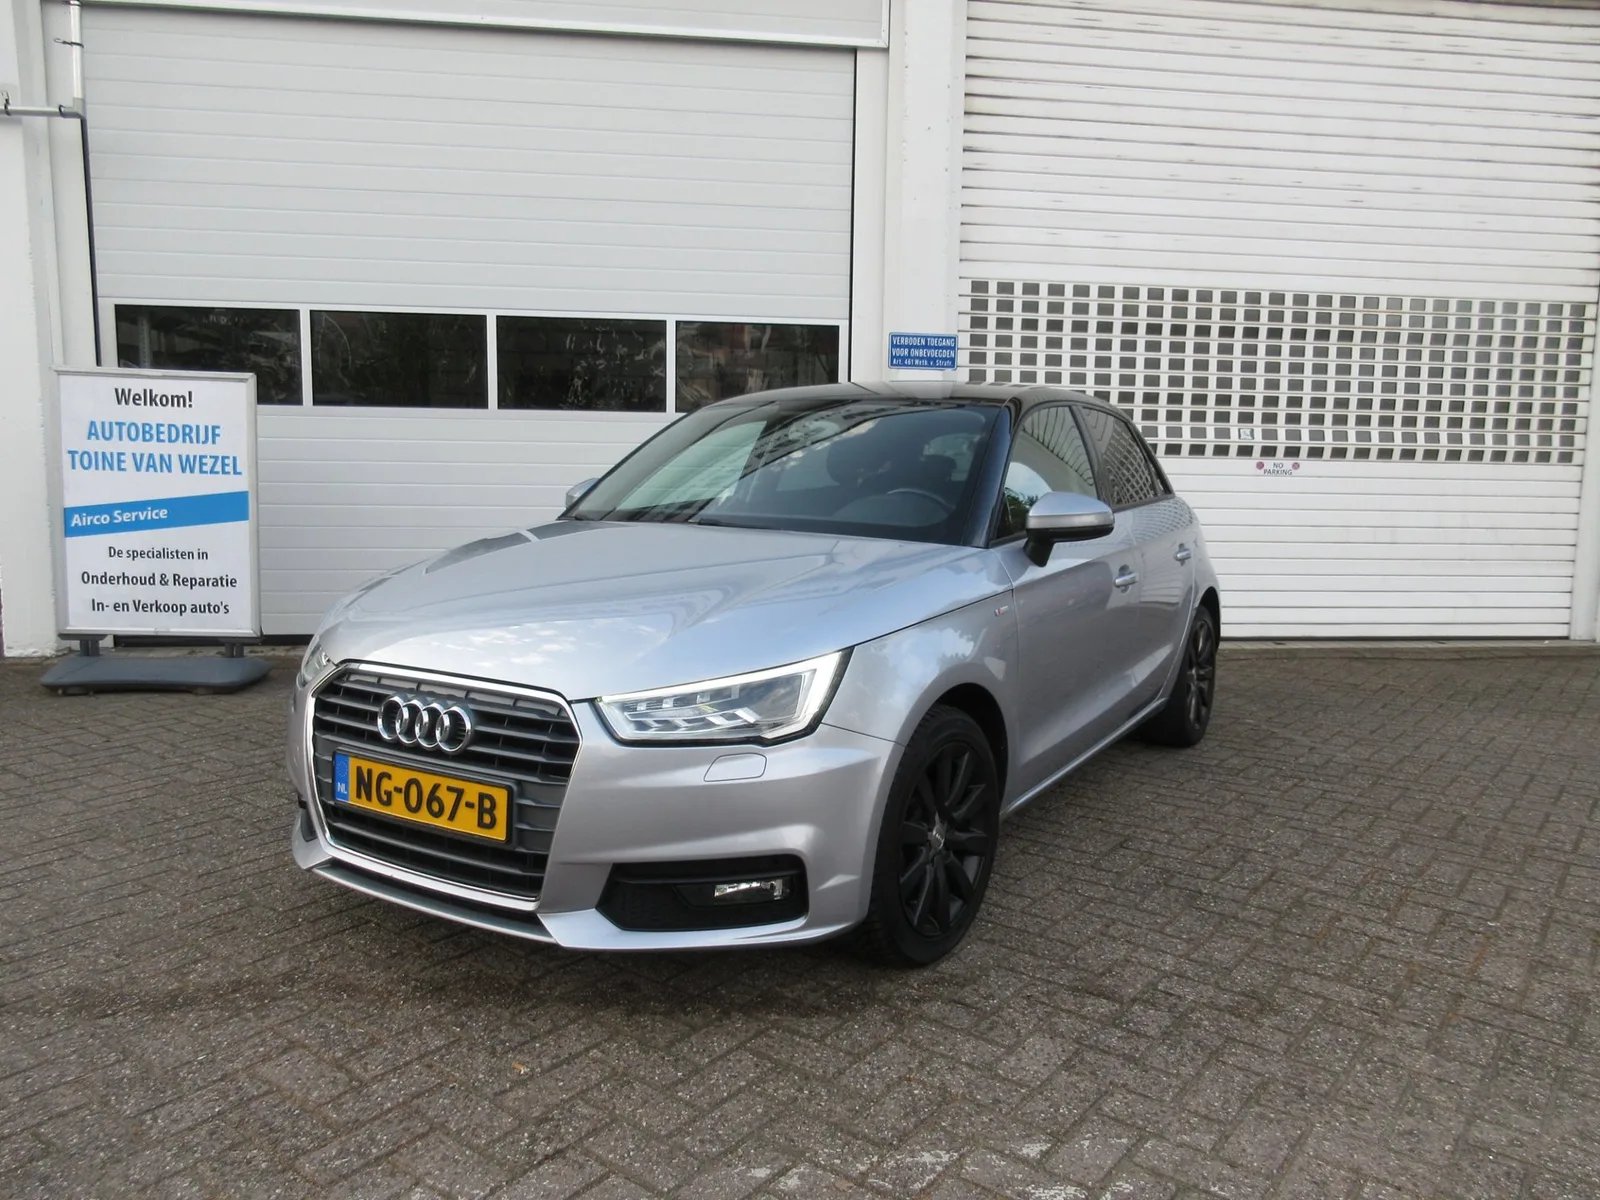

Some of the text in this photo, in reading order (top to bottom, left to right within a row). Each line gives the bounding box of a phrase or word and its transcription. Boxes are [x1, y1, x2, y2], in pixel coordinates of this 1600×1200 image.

[892, 336, 955, 347] VERBODEN TOEGANG
[892, 347, 955, 358] VOOR ONBEVOEGDEN
[115, 388, 193, 408] Welkom!
[87, 420, 221, 445] AUTOBEDRIJF
[68, 450, 242, 476] TOINE VAN WEZEL
[71, 507, 168, 528] Airco Service
[108, 546, 209, 562] De specialisten in
[81, 571, 238, 590] Onderhoud & Reparatie
[91, 599, 230, 616] In- en Verkoop auto's
[337, 782, 348, 794] NL
[355, 765, 497, 830] NG-067-B
